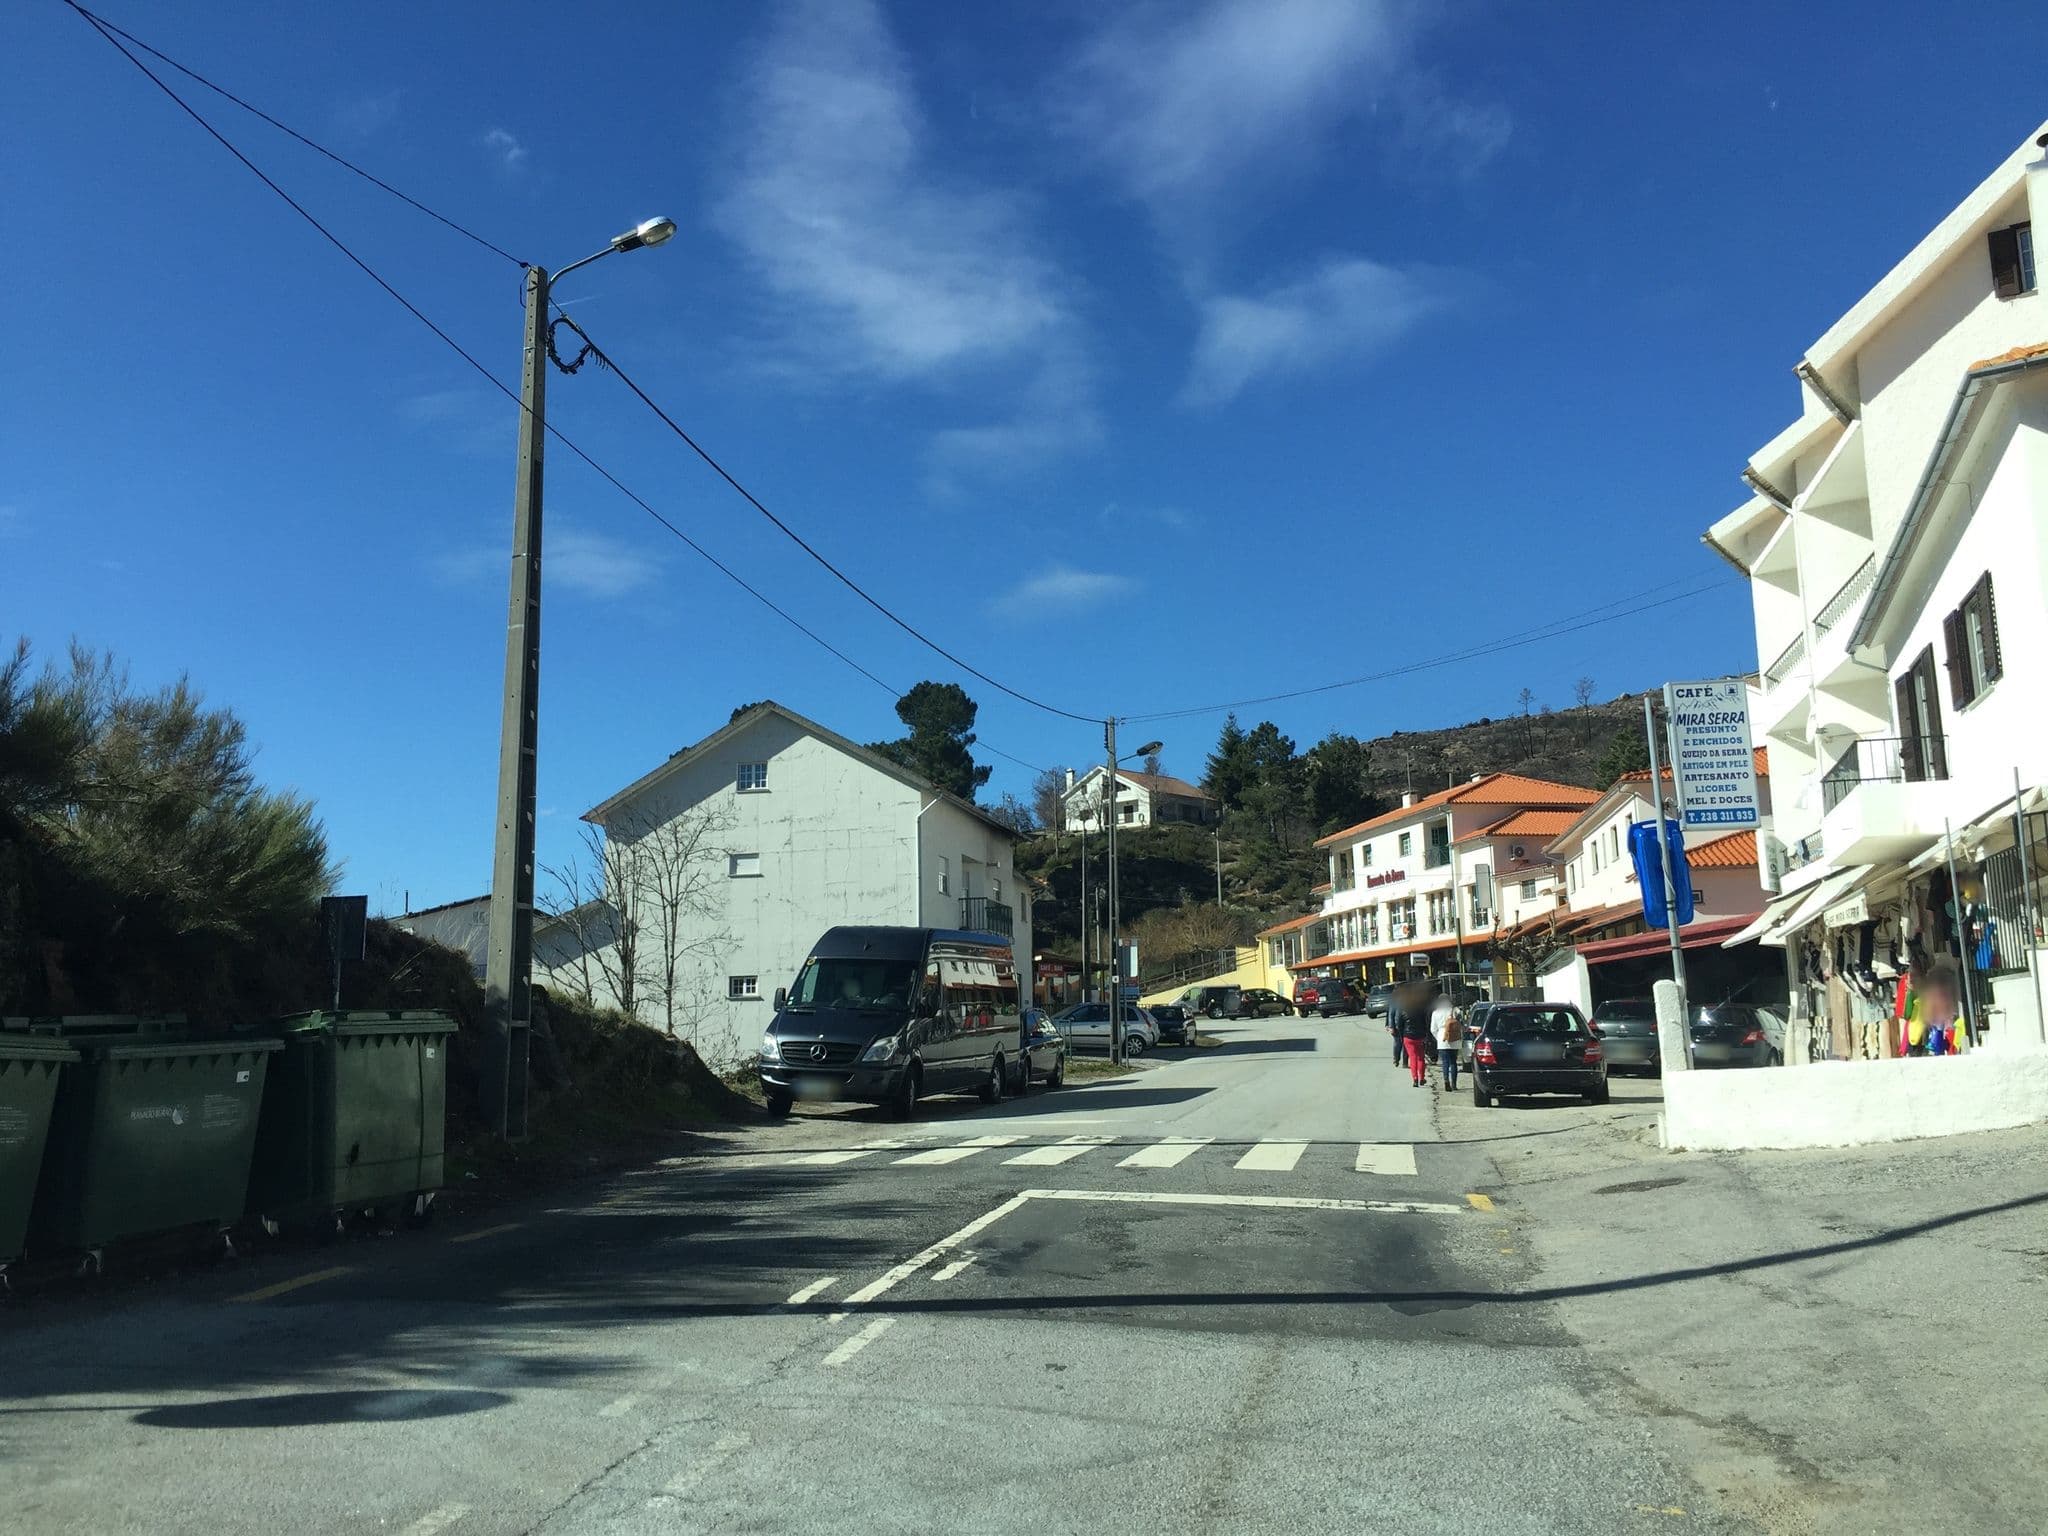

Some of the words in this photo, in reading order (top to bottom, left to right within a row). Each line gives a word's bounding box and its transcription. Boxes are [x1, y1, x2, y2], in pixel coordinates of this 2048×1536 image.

[1676, 685, 1713, 698] CAFÉ
[1676, 713, 1706, 726] MIRA
[1708, 711, 1745, 725] SERRA
[1686, 726, 1738, 734] PRESUNTO
[1692, 736, 1743, 746] ENCHIDOS
[1682, 750, 1708, 758] QUEIJO
[1710, 750, 1720, 758] DA
[1722, 748, 1748, 756] SERRA
[1684, 772, 1749, 782] ARTESANATO
[1696, 784, 1738, 792] LICORES
[1686, 798, 1707, 806] MEL
[1719, 796, 1752, 804] DOCES
[1688, 812, 1698, 822] T.
[1700, 812, 1718, 822] 238
[1720, 812, 1735, 820] 311
[1736, 810, 1753, 820] 935
